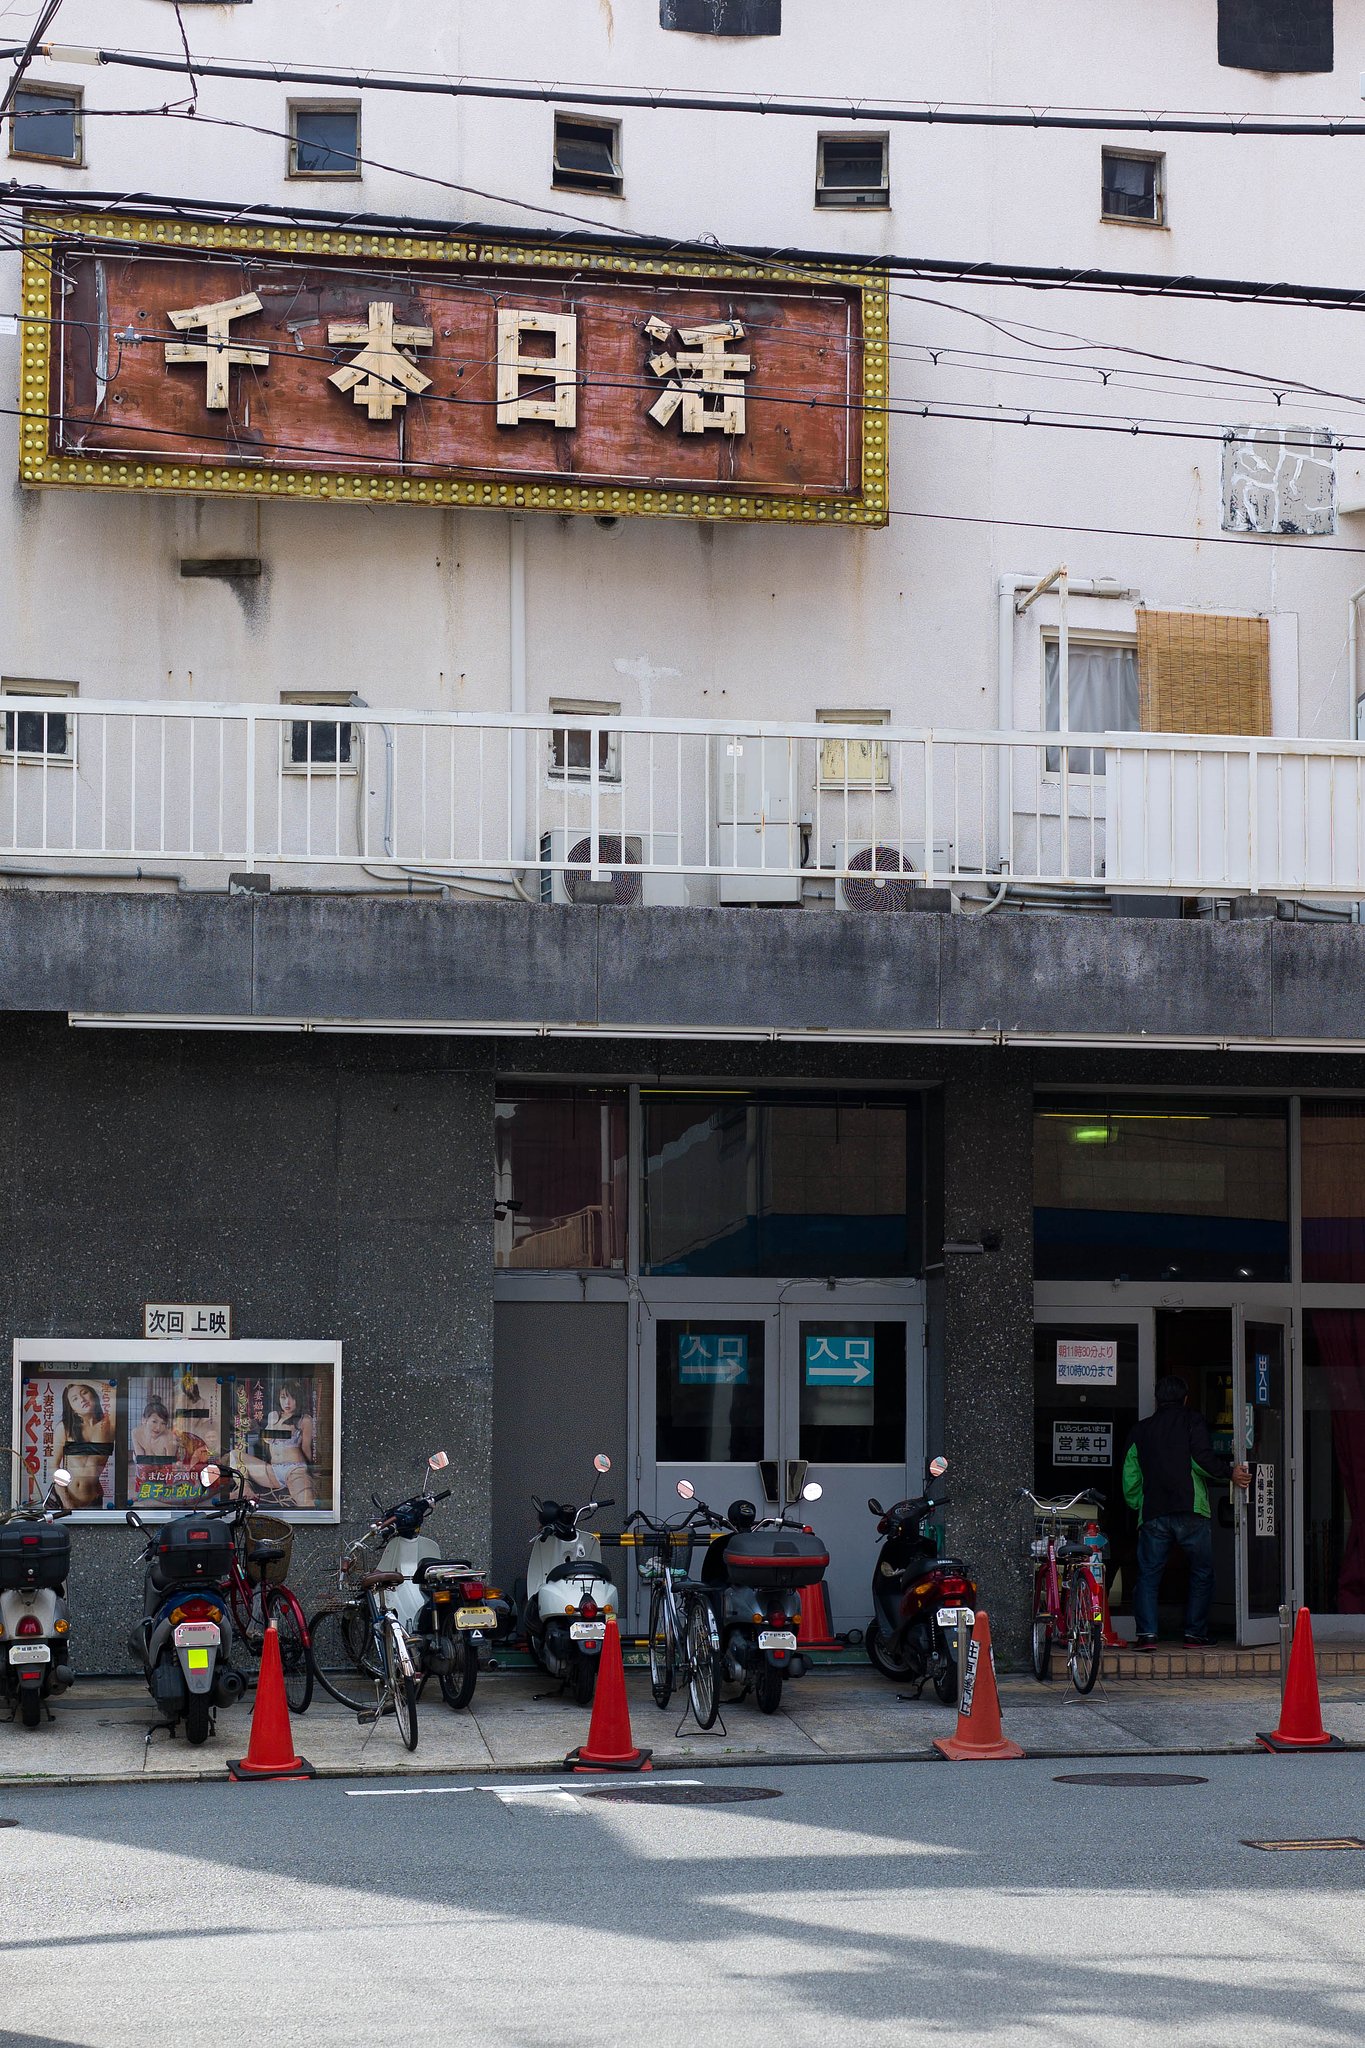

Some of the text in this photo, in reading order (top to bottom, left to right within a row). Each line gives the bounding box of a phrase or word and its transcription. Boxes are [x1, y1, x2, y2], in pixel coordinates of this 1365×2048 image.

[164, 291, 752, 435] 千本日活
[148, 1310, 227, 1334] 次回 上映
[682, 1336, 743, 1360] 入口
[809, 1338, 870, 1361] 入口
[1058, 1344, 1114, 1359] 朝11時30分より
[1058, 1364, 1114, 1378] 夜10時00分まで
[1257, 1355, 1268, 1402] 出入口
[43, 1381, 55, 1457] 人妻浮気調査
[1059, 1424, 1106, 1433] いらっしゃいませ
[1058, 1436, 1107, 1452] 営業中
[138, 1483, 208, 1499] 息子が欲しい
